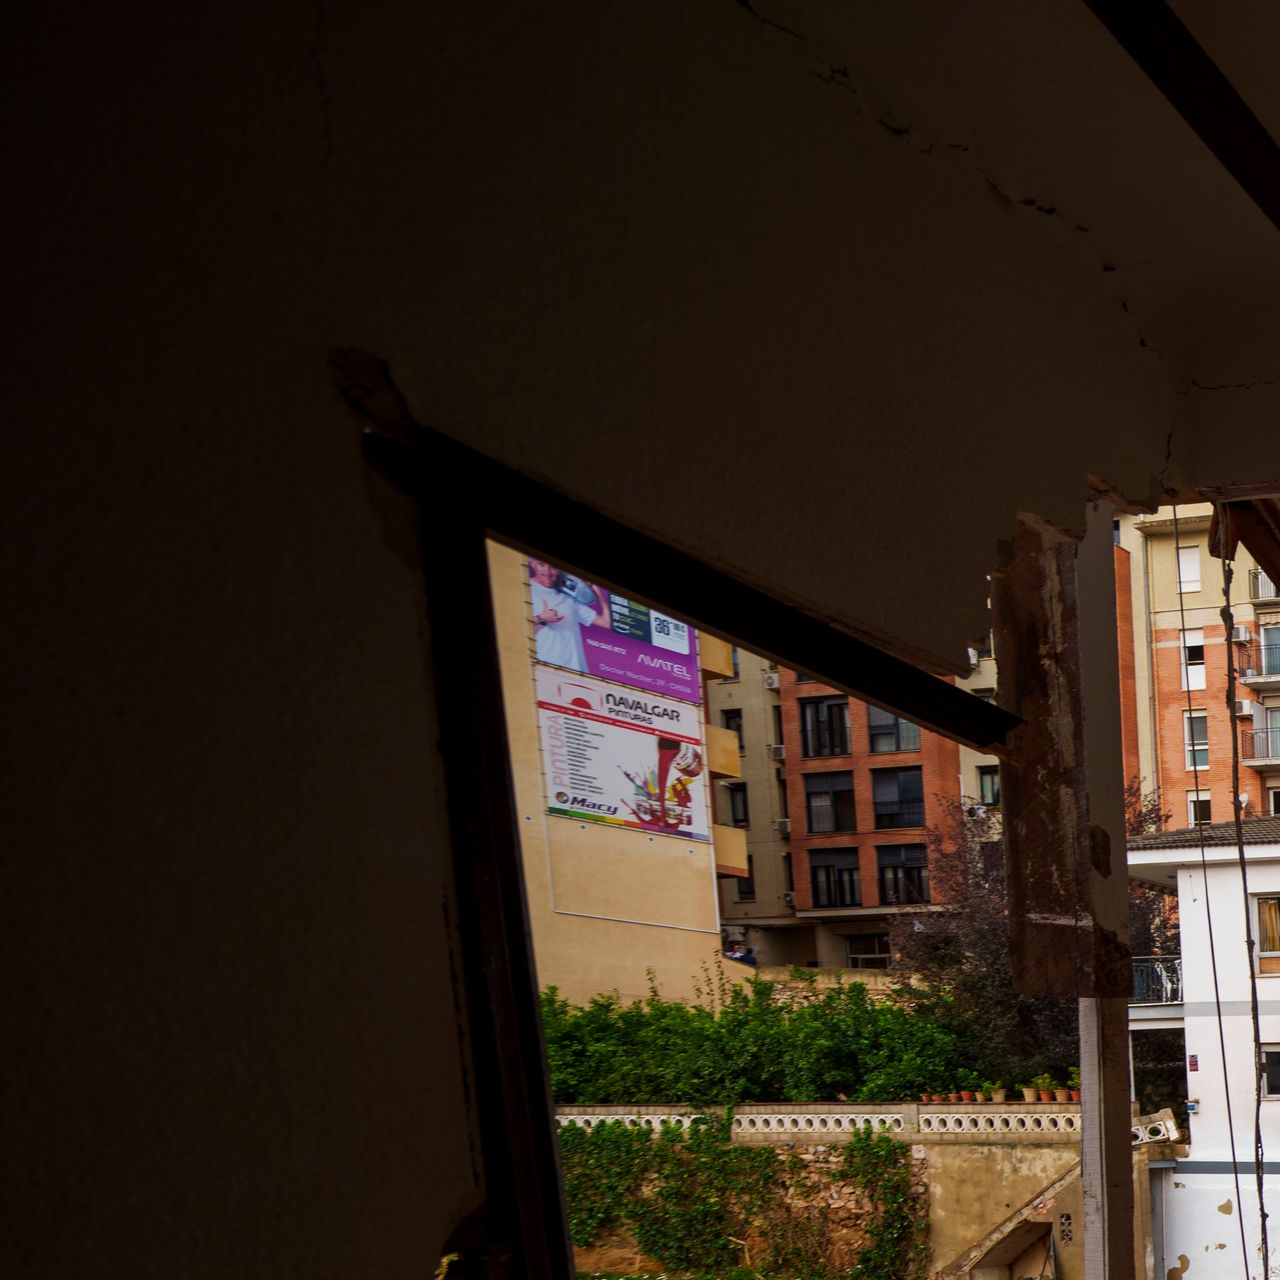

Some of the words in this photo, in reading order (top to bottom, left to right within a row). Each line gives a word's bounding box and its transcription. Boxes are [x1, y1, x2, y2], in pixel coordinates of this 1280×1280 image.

[636, 654, 692, 678] AVATEL
[605, 693, 681, 723] NAVALGAR
[570, 796, 619, 815] Macy
